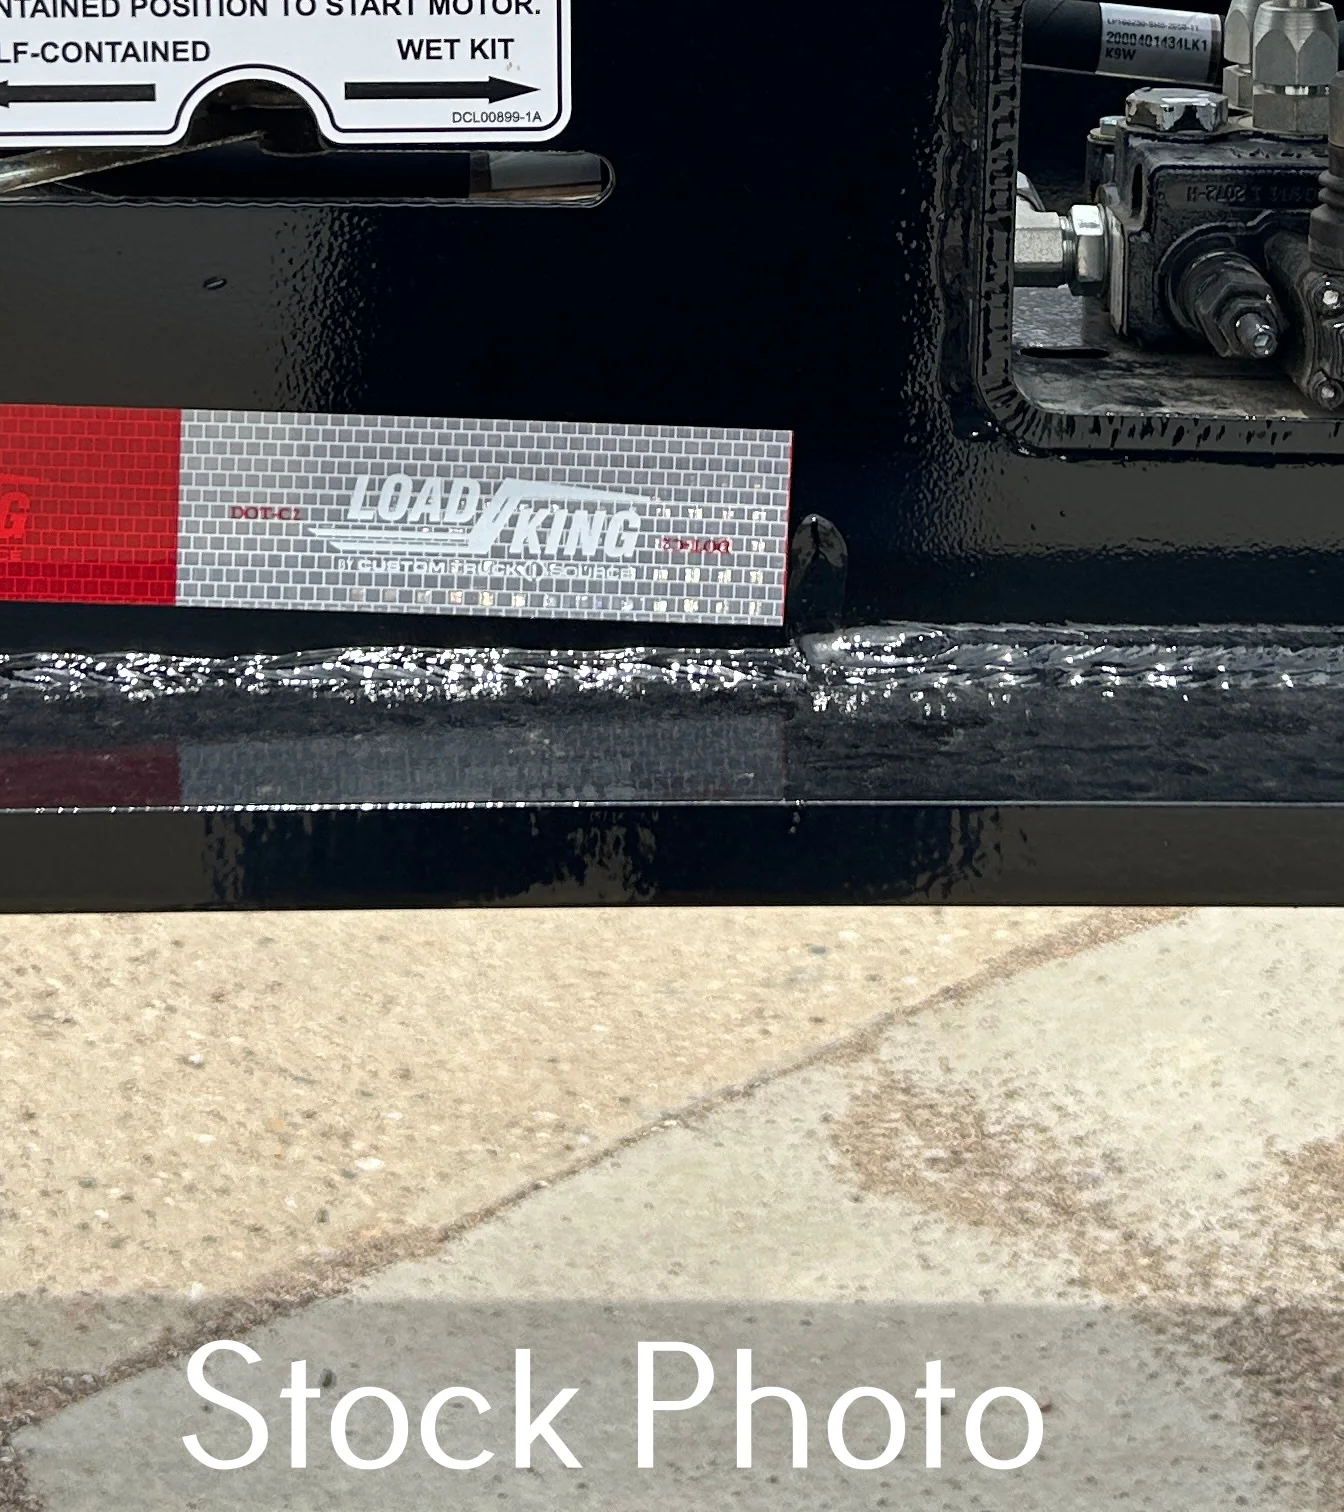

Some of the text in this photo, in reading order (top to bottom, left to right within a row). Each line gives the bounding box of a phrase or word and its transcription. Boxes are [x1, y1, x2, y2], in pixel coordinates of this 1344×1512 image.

[397, 39, 460, 60] WET
[471, 38, 514, 59] KIT
[453, 111, 541, 123] DCL00899-1A
[347, 475, 642, 557] LOAD KING
[358, 559, 637, 581] CUSTOM TRUCK SOURCE
